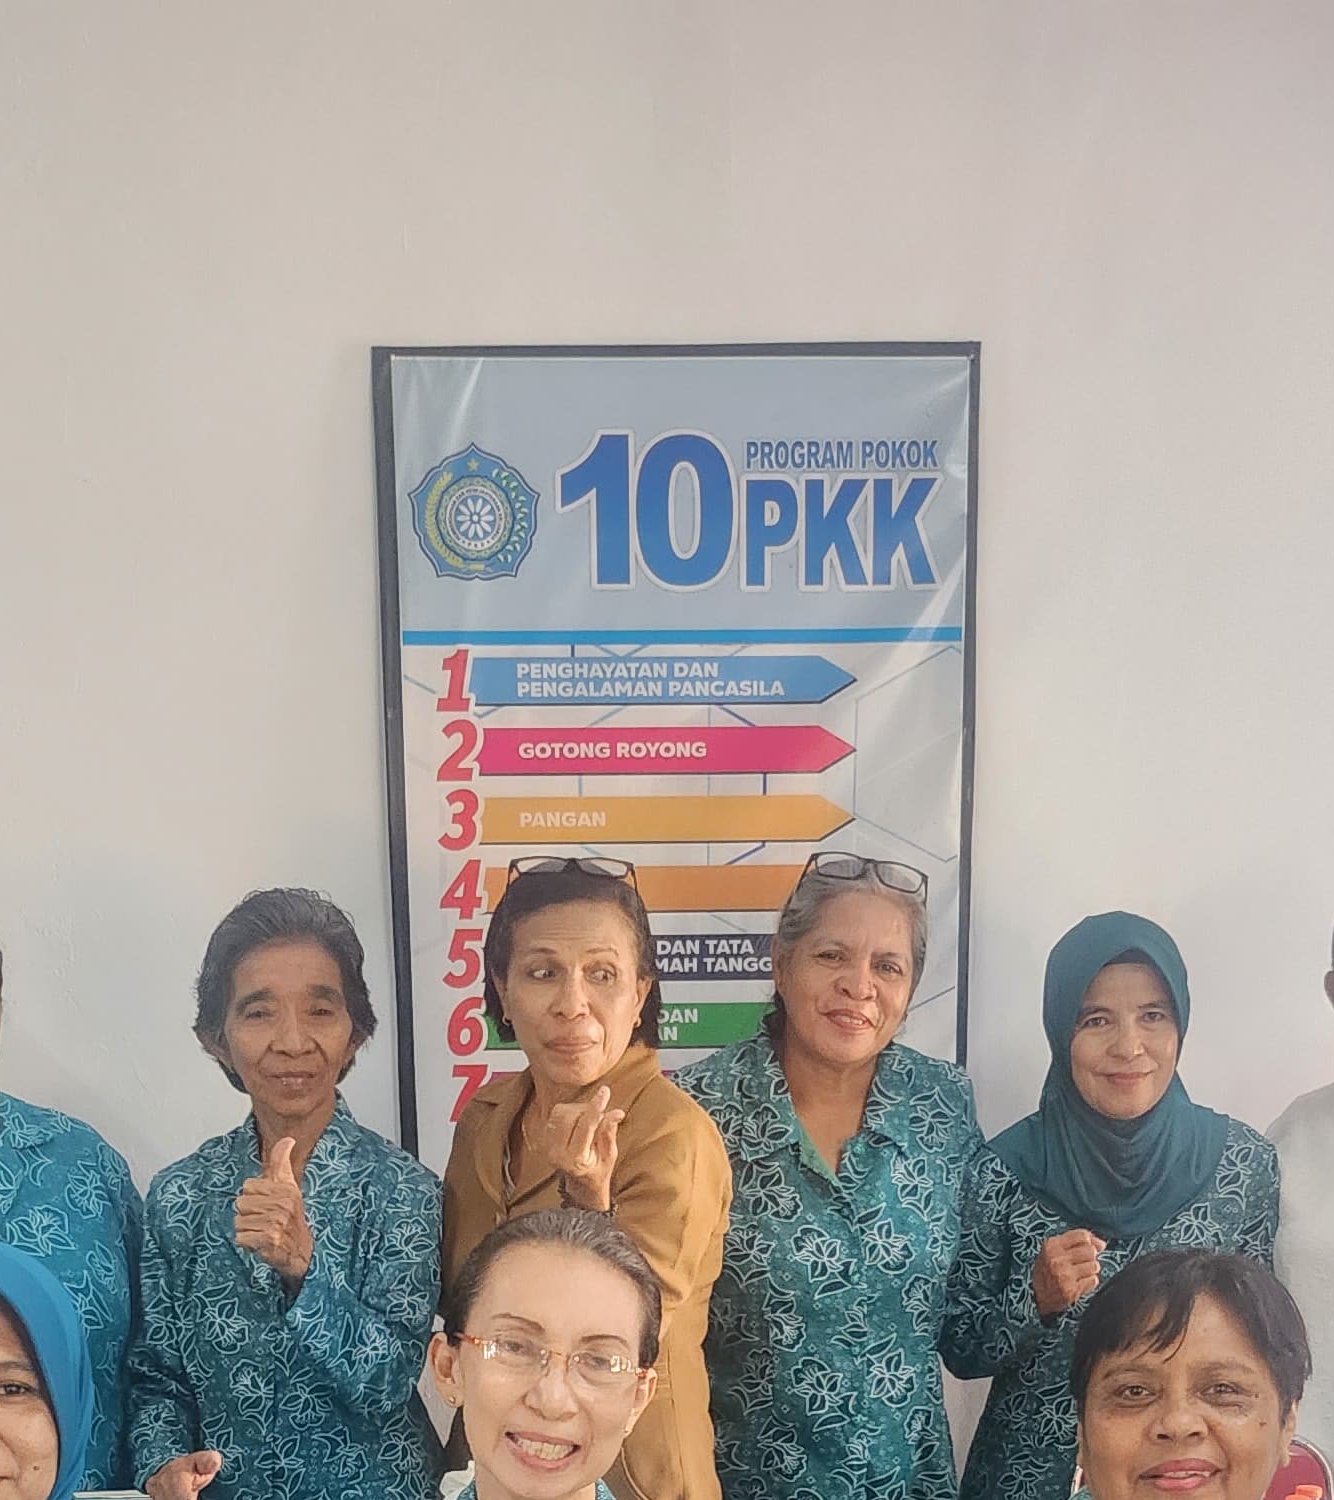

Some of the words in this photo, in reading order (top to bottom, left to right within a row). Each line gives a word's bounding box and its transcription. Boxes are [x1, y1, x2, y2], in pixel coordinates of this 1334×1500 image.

[745, 440, 853, 470] PROGRAM
[861, 439, 939, 468] POKOK
[560, 433, 734, 586] 10
[745, 477, 939, 587] PKK
[436, 649, 471, 712] 1
[516, 662, 668, 679] PENGHAYATAN
[673, 661, 719, 678] DAN
[516, 680, 663, 698] PENGALAMAN
[668, 679, 785, 697] PANCASILA
[436, 719, 479, 782] 2
[518, 742, 612, 760] GOTONG
[616, 741, 708, 759] ROYONG
[437, 789, 480, 851] 3
[519, 811, 607, 828] PANGAN
[440, 860, 483, 920] 4
[442, 929, 484, 989] 5
[656, 939, 700, 956] DAN
[704, 938, 755, 955] TATA
[447, 996, 484, 1057] 6
[449, 1064, 488, 1122] 7
